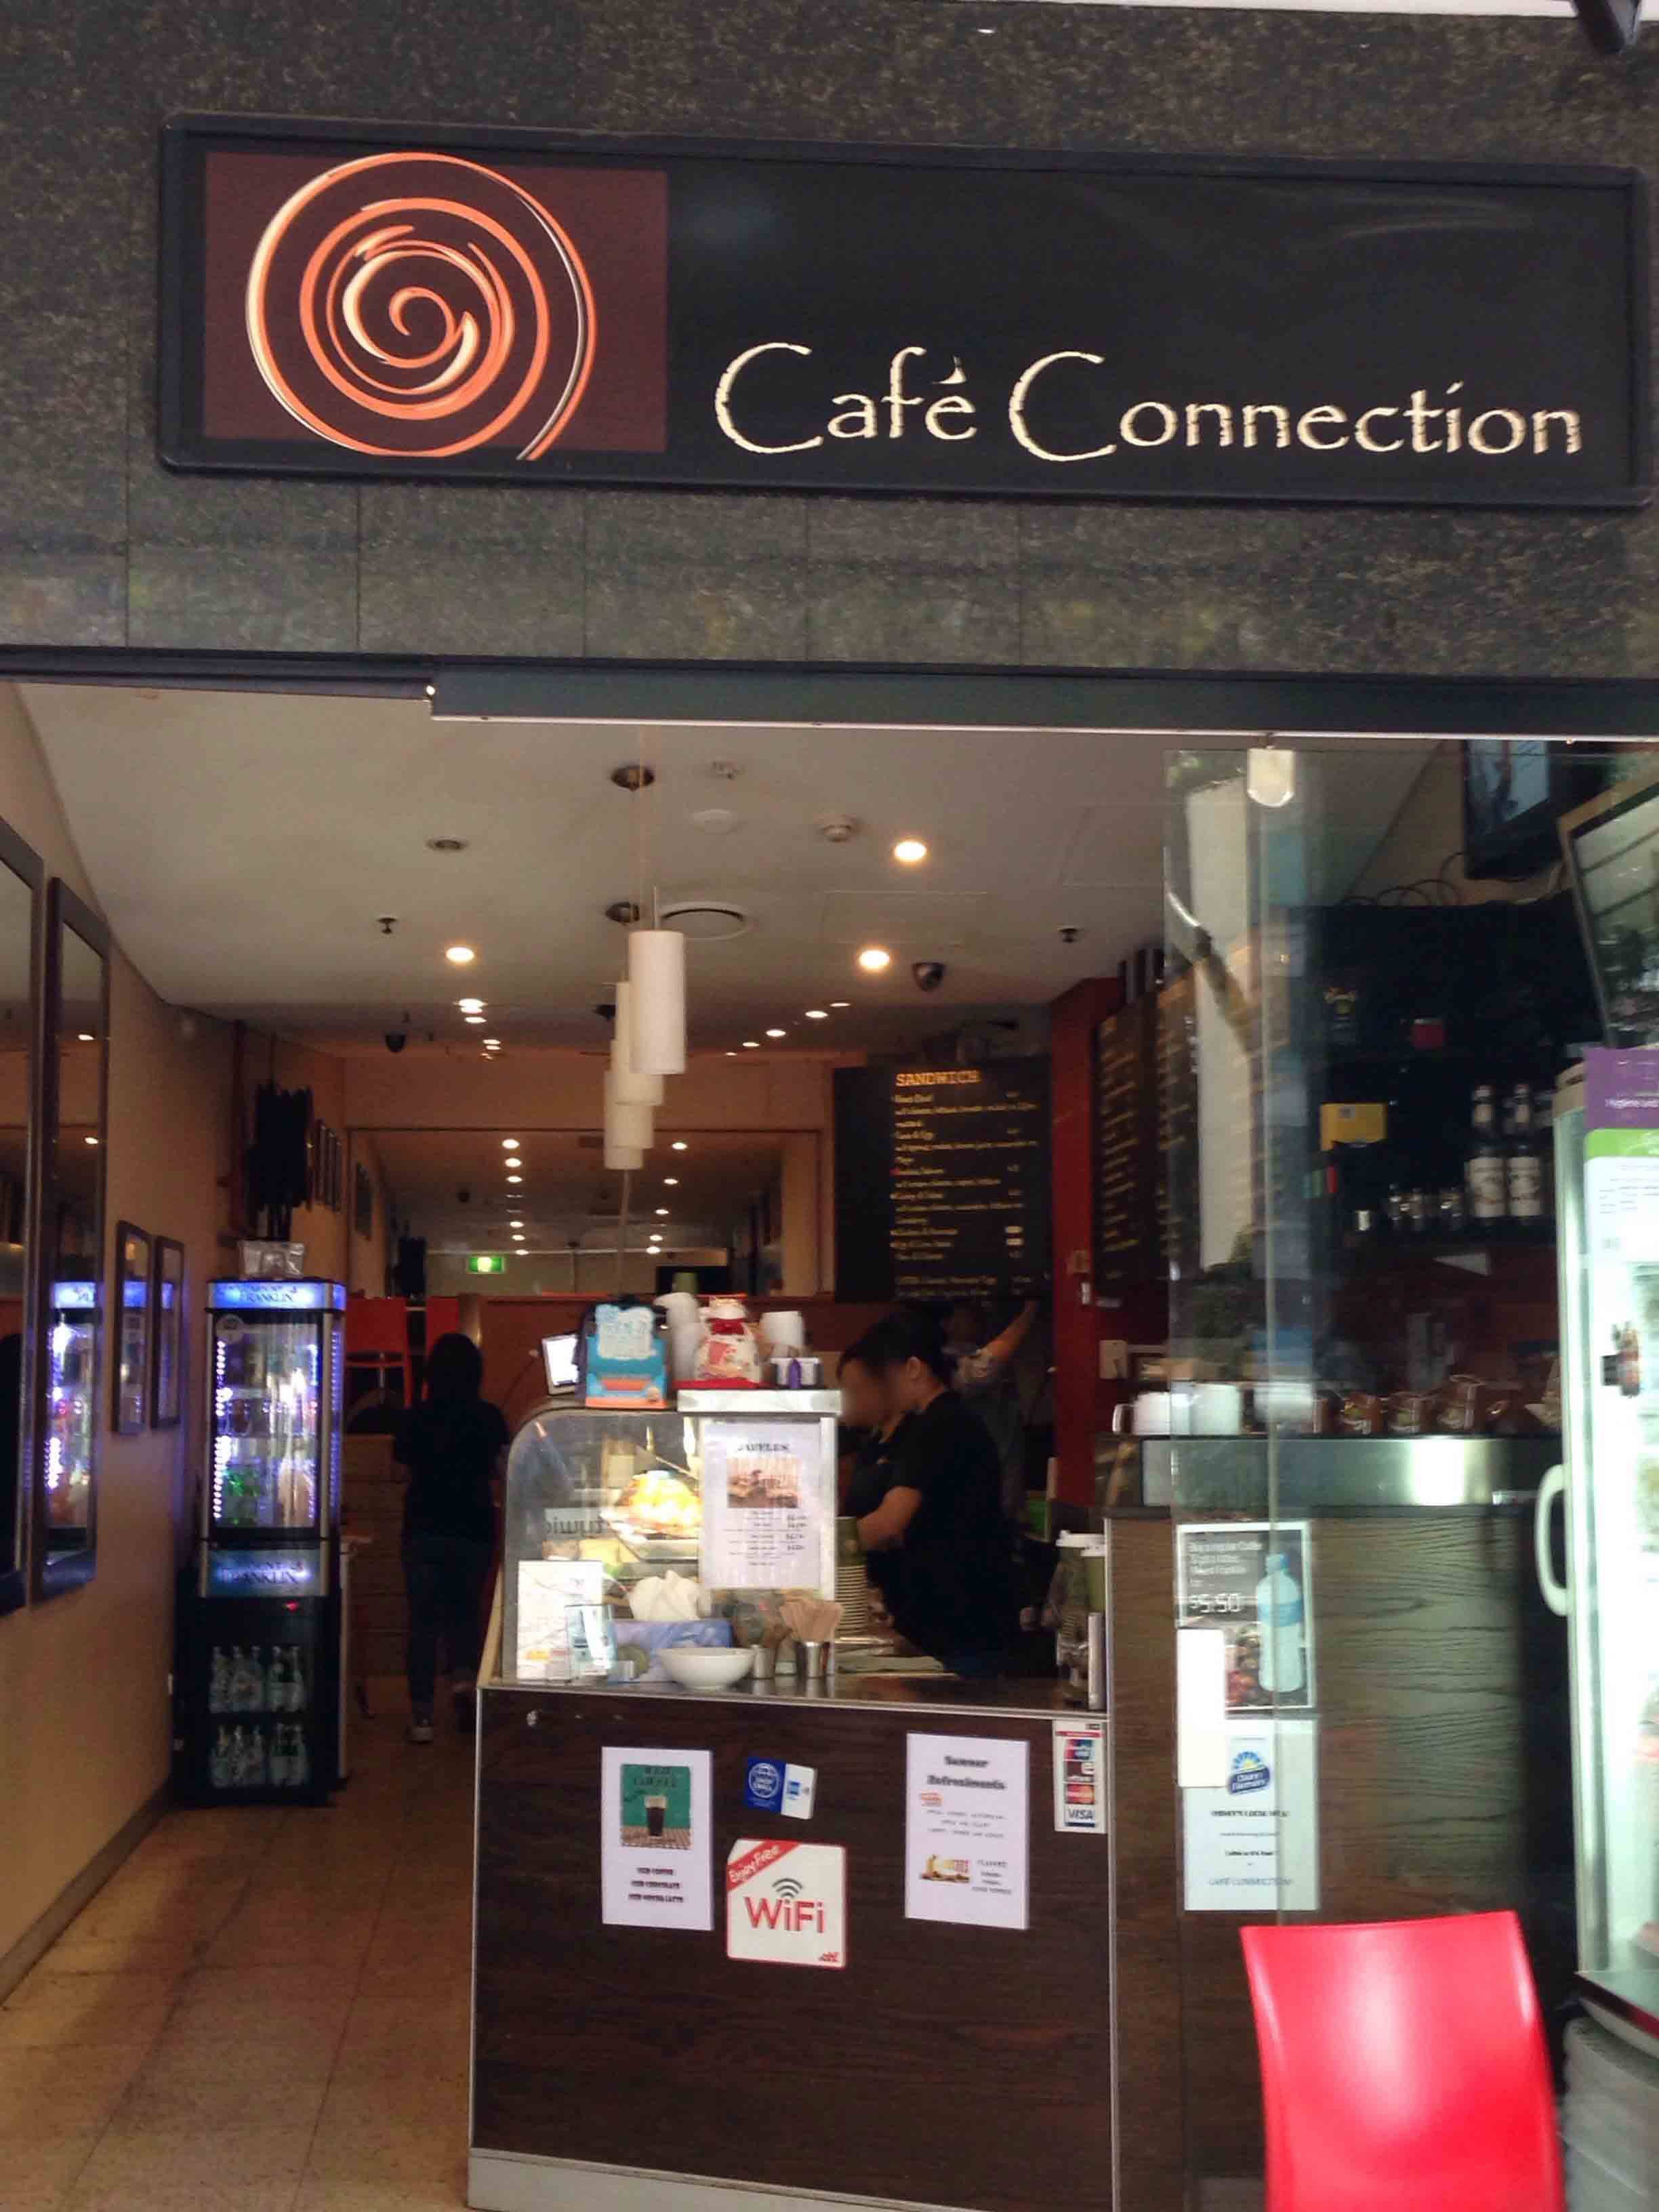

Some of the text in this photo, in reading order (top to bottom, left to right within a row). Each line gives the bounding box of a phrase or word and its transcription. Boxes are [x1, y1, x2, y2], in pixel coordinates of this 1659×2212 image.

[715, 342, 1582, 463] Café Connection
[1067, 1808, 1094, 1820] VISA
[744, 1897, 825, 1933] WiFi
